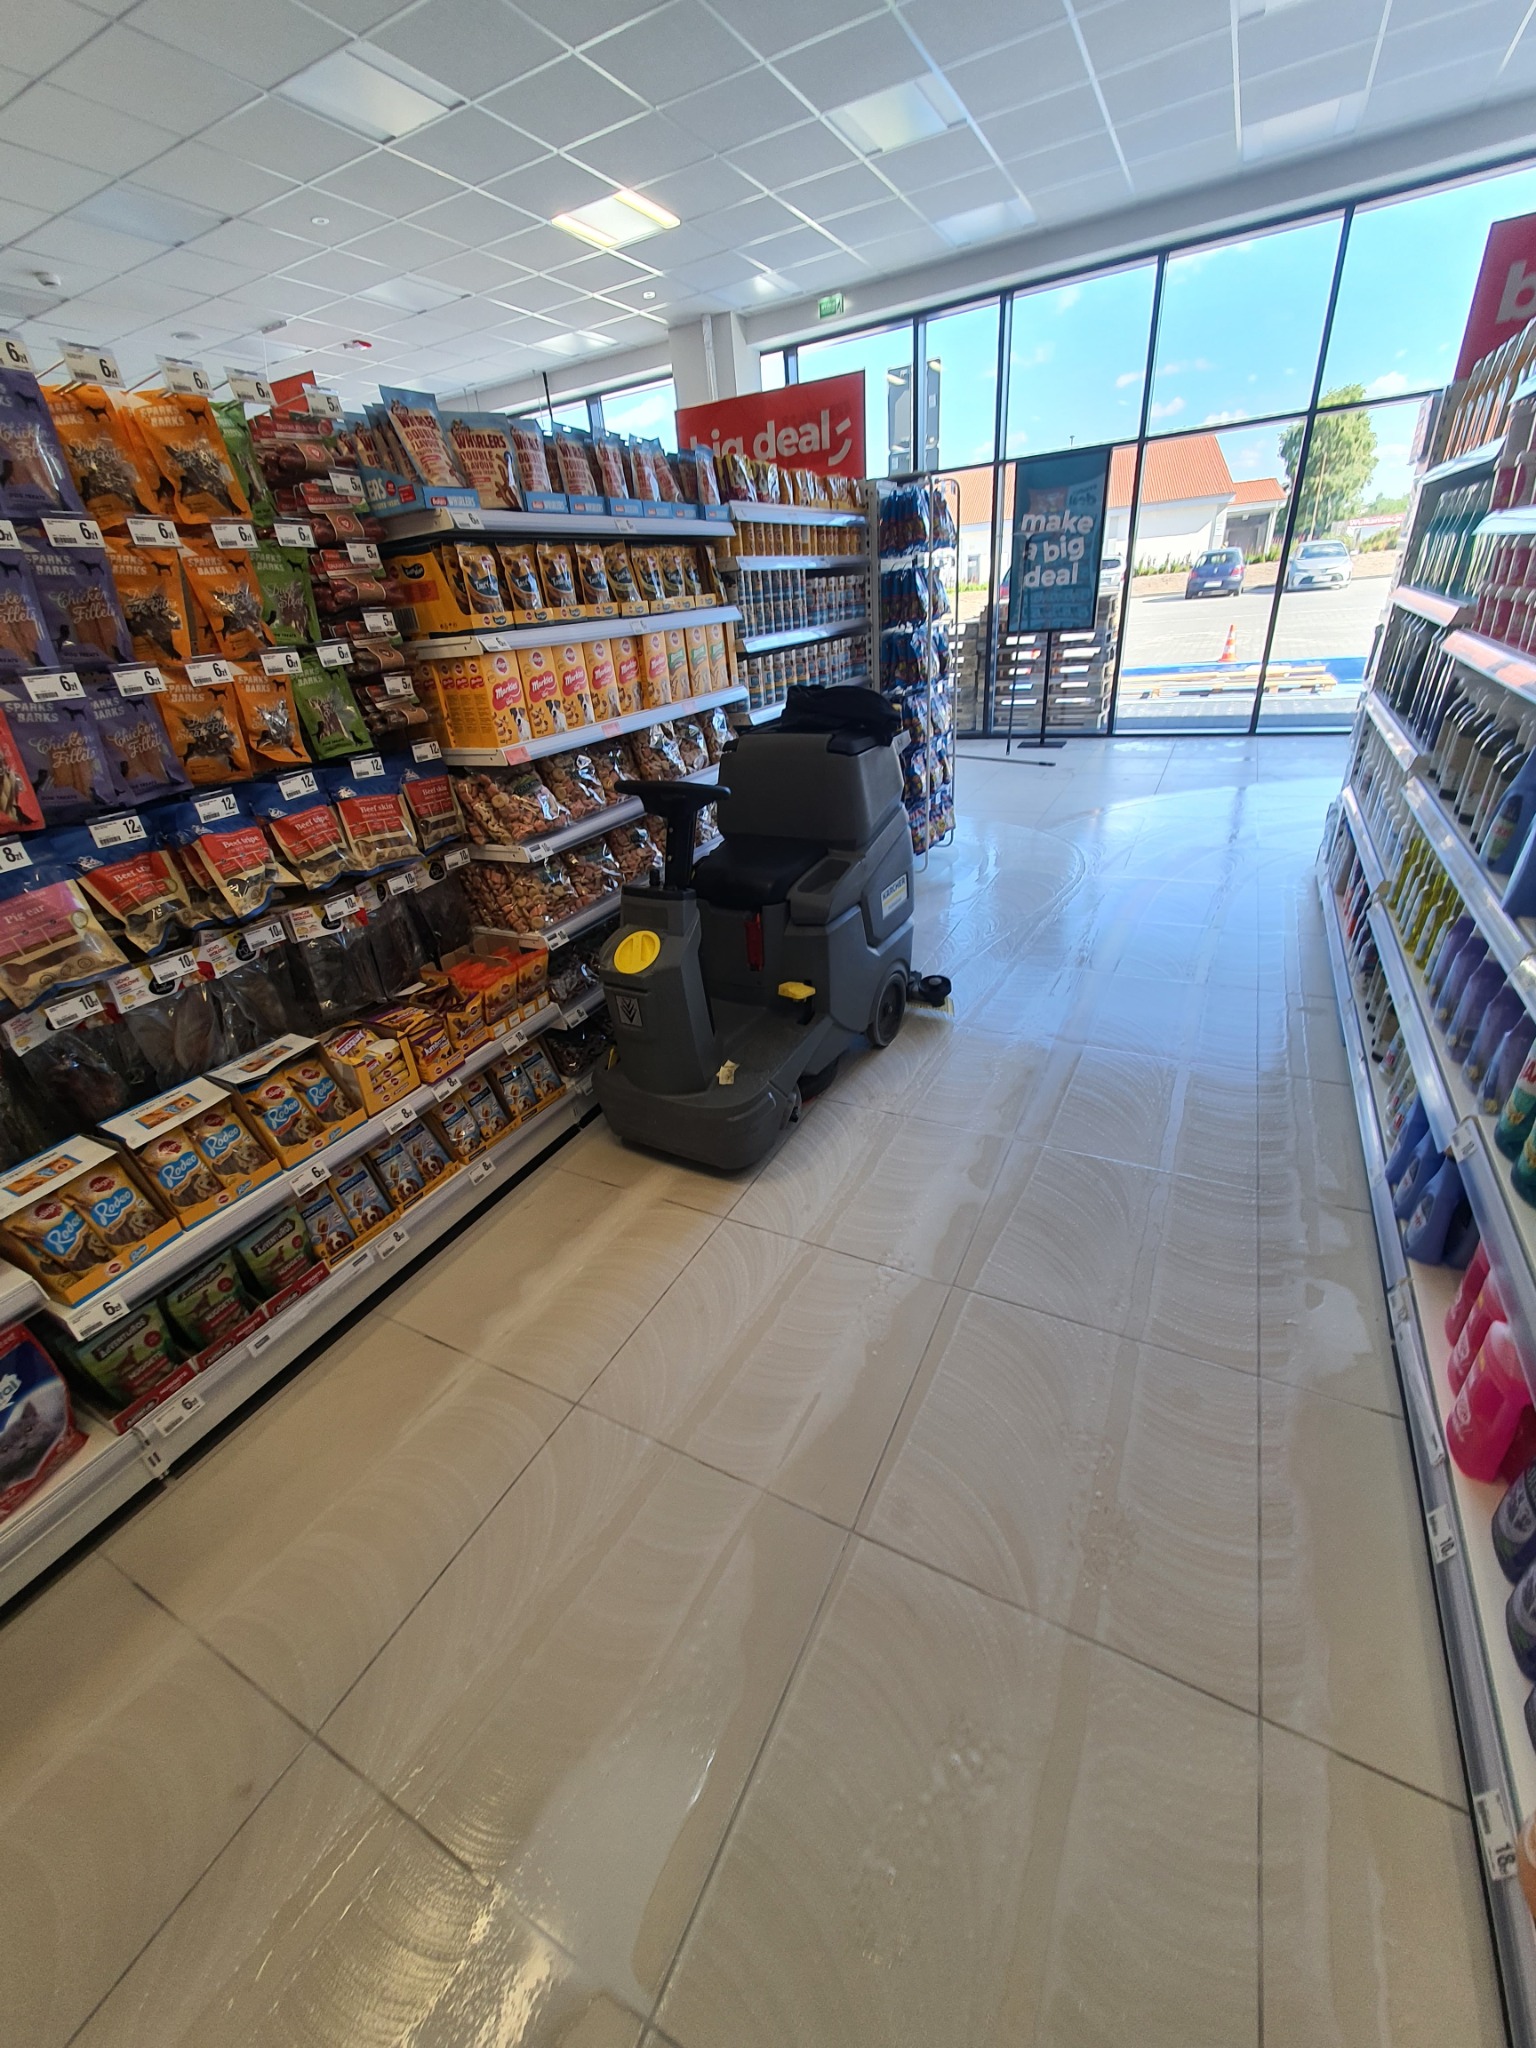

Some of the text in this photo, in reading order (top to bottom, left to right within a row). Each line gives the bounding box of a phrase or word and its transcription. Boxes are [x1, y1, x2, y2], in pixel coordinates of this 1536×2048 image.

[454, 433, 507, 449] WHIRLERS
[753, 409, 830, 461] deal
[460, 451, 496, 464] DOUBLE
[1021, 509, 1094, 535] make
[1043, 535, 1086, 564] big
[1024, 562, 1079, 588] deal
[359, 802, 395, 814] Beef skin
[4, 902, 45, 925] Pig ear
[267, 1099, 299, 1130] Rodeo
[205, 1127, 239, 1158] Rodeo
[161, 1153, 197, 1188] Rodeo
[95, 1190, 132, 1226] Rodeo
